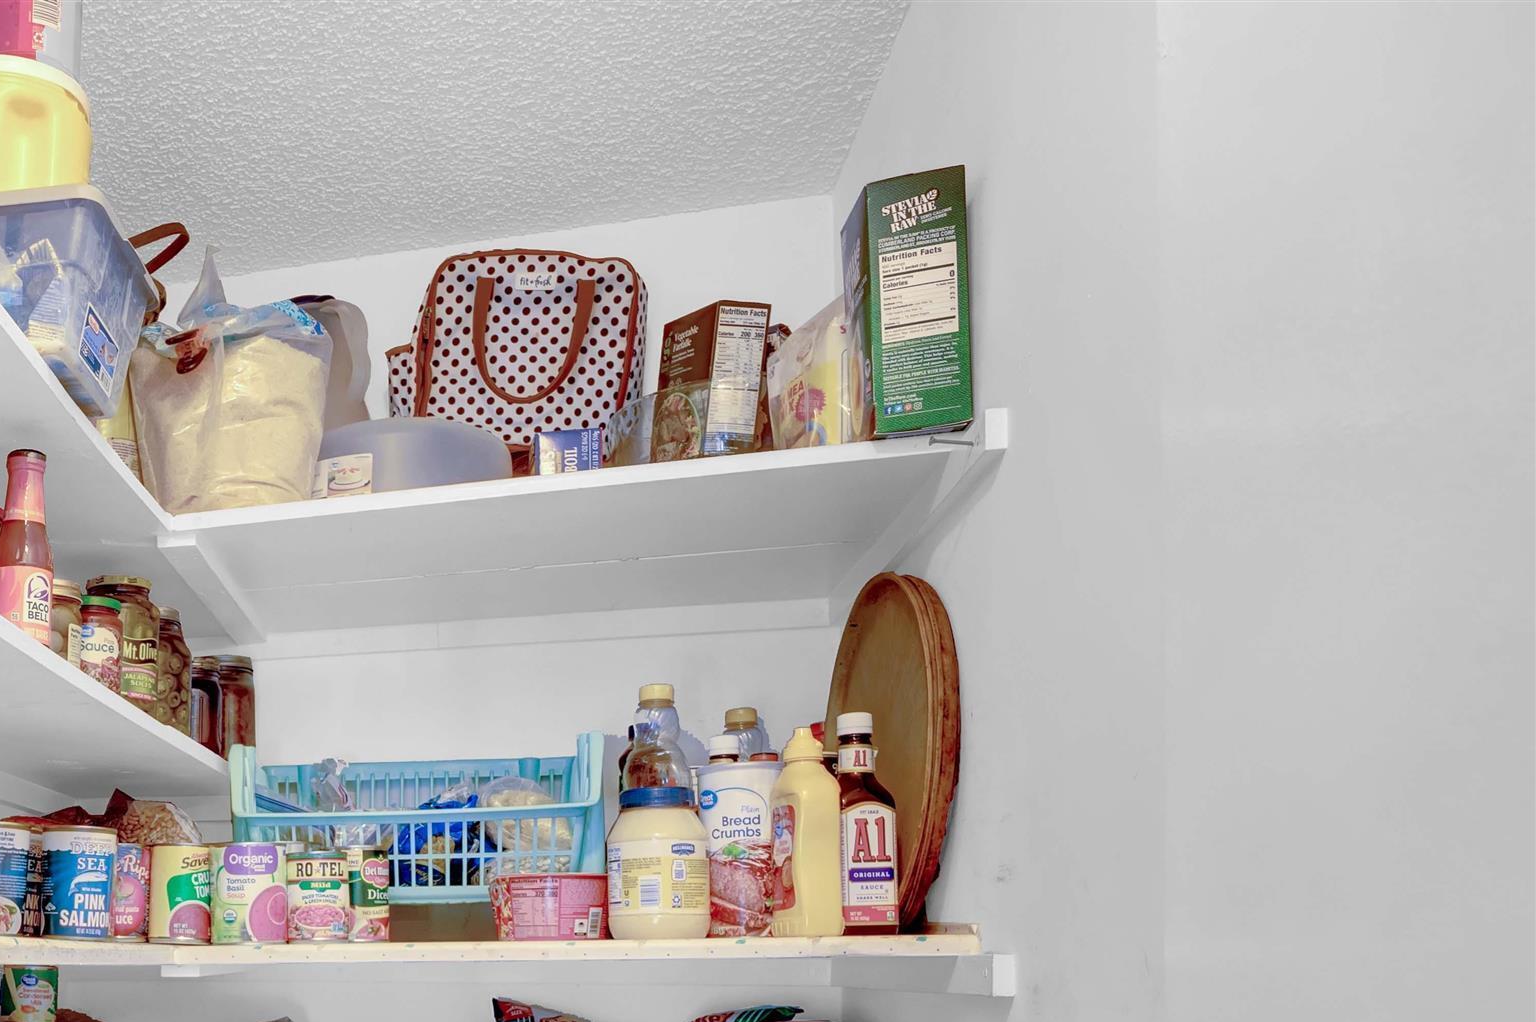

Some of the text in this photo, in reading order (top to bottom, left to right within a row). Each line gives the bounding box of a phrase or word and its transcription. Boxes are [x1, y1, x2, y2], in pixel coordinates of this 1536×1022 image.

[881, 194, 928, 216] STEVIA
[892, 201, 936, 222] IN THE
[890, 216, 917, 233] RAW
[882, 246, 942, 263] Nutrition Facts
[883, 281, 908, 289] Calories
[720, 308, 748, 316] Nutrition
[564, 447, 578, 472] BOIL
[26, 601, 48, 613] TACO
[28, 611, 48, 623] BELL
[722, 815, 761, 827] Bread
[711, 827, 761, 840] Crumbs
[70, 841, 114, 856] DEEP
[77, 858, 106, 870] SEA
[229, 853, 274, 866] Organic
[853, 871, 891, 879] ORIGINAL
[74, 894, 106, 910] PINK
